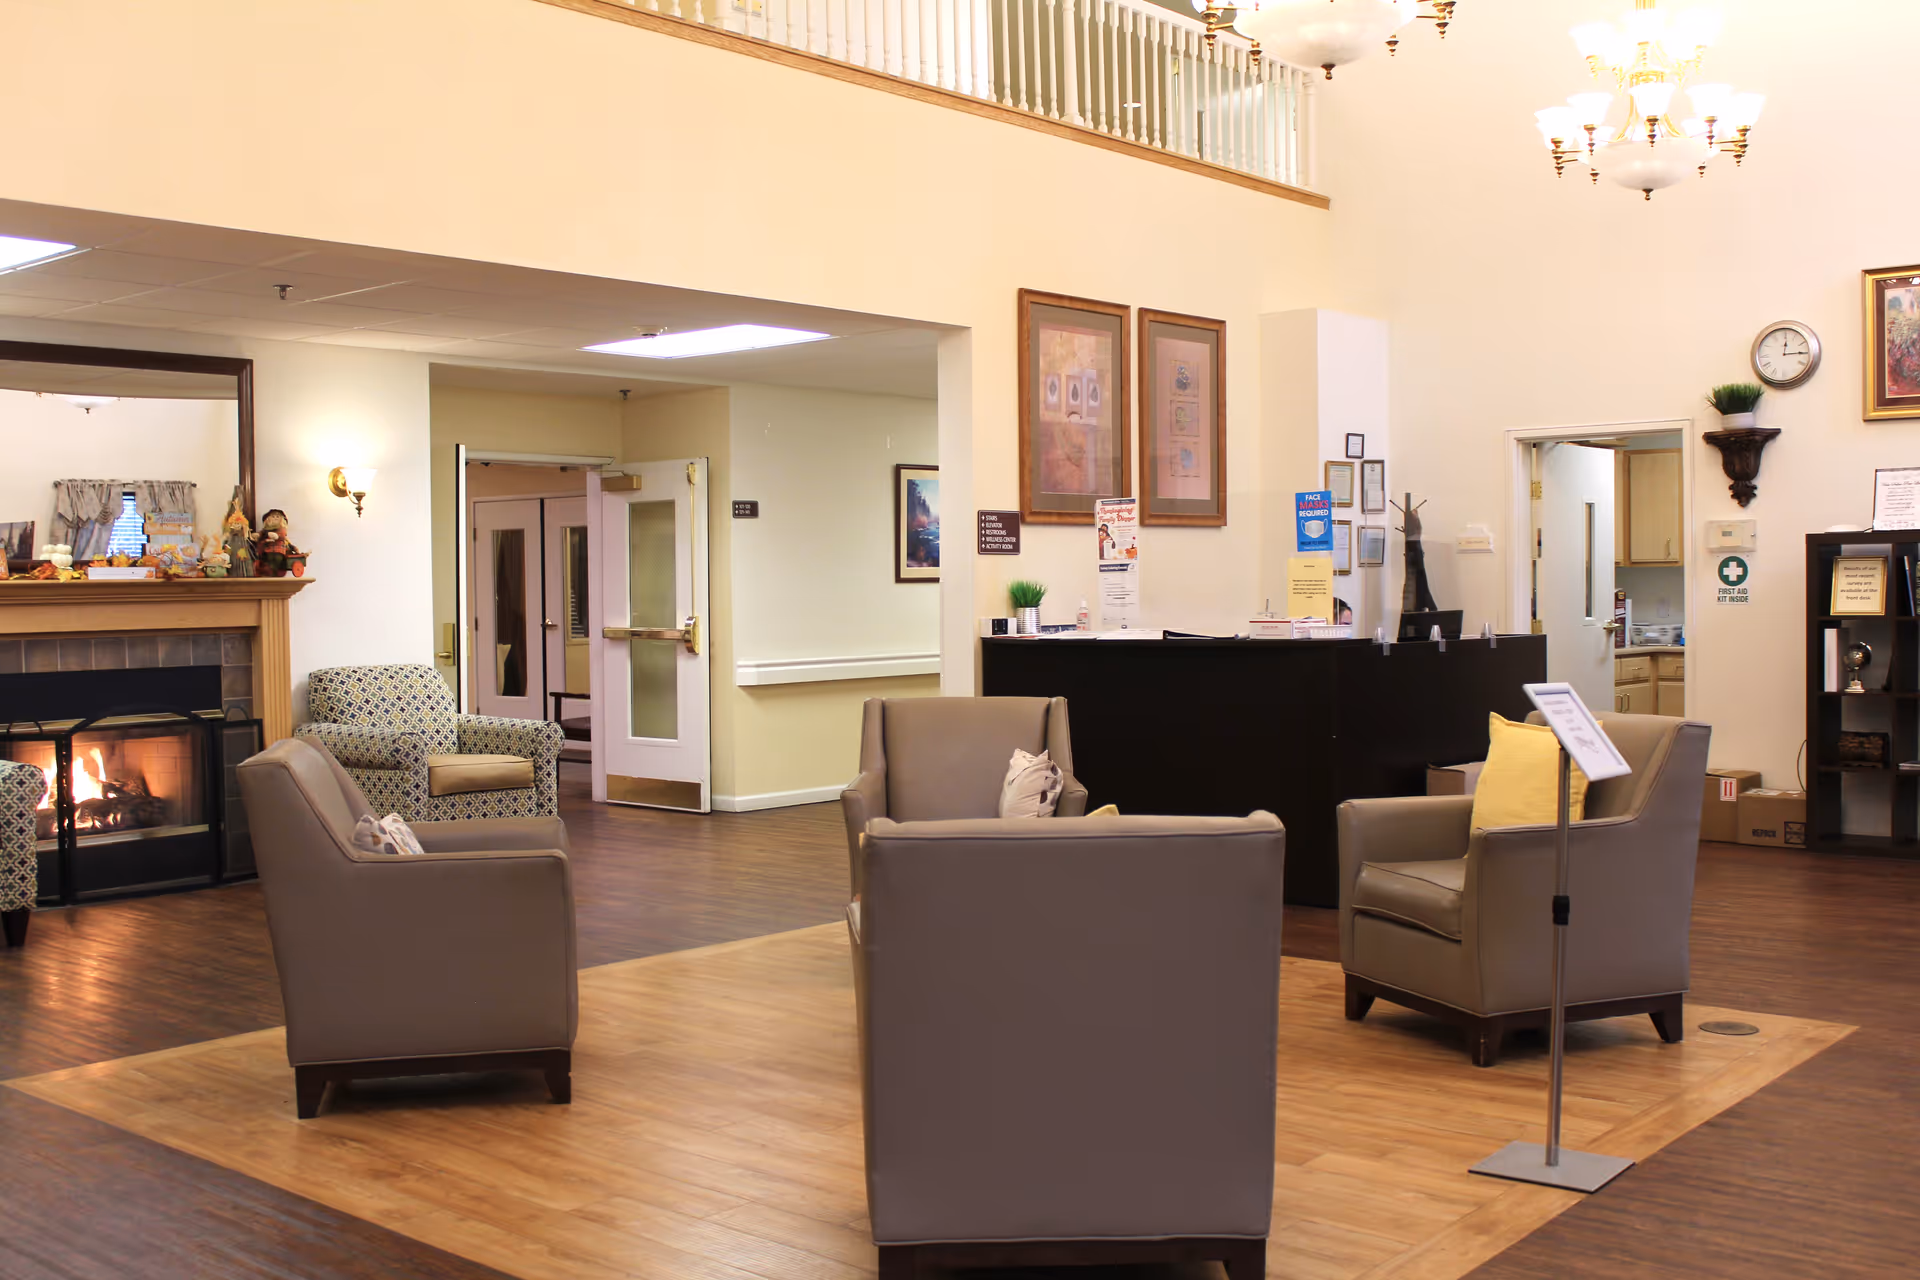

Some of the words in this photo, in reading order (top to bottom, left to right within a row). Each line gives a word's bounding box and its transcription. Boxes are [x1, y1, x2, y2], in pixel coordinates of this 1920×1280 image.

[1299, 500, 1329, 510] MASKS
[1299, 509, 1329, 517] REQUIRED
[1718, 587, 1736, 595] FIRST
[1736, 587, 1748, 595] AID
[1716, 595, 1728, 603] KIT
[1728, 595, 1749, 603] INSIDE
